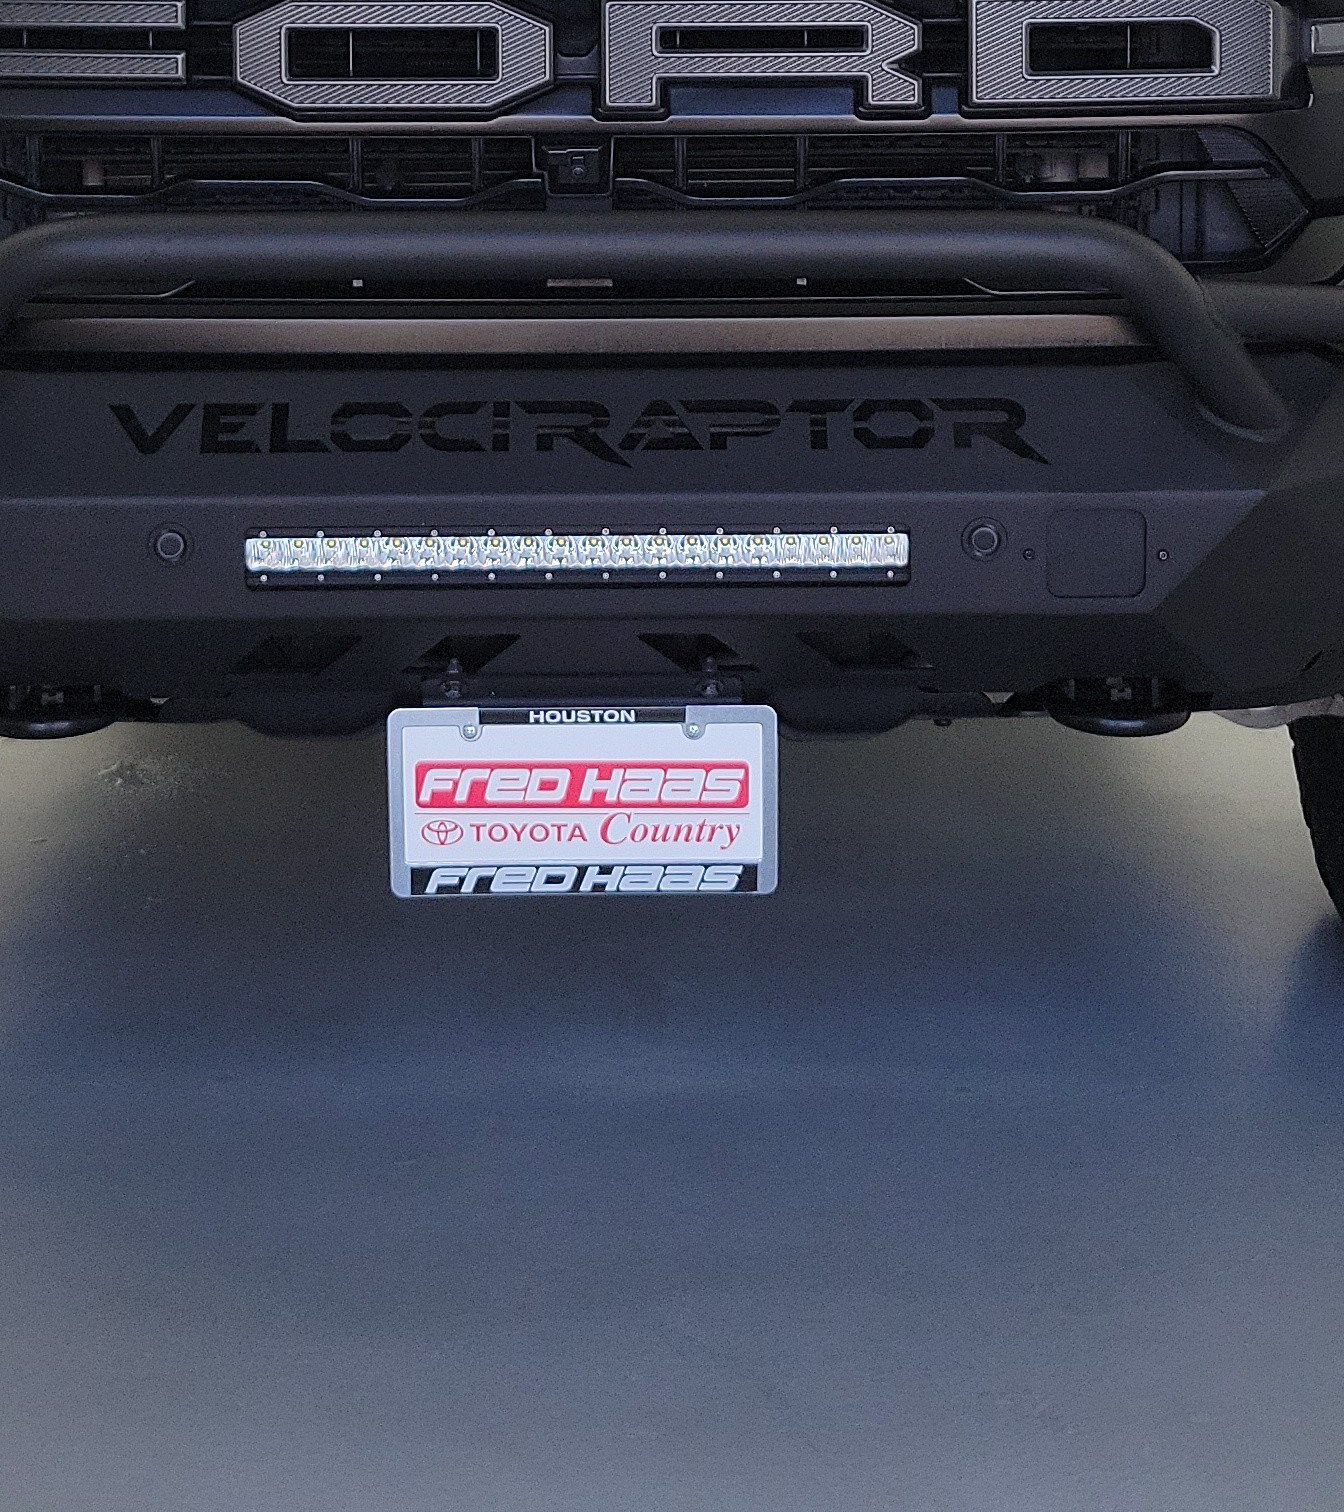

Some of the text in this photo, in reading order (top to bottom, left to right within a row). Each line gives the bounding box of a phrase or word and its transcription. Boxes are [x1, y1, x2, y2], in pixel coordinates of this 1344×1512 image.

[109, 397, 1051, 469] VELOCIRAPTOR
[529, 710, 636, 723] HOUSTON
[469, 811, 741, 850] TOYOTA Country
